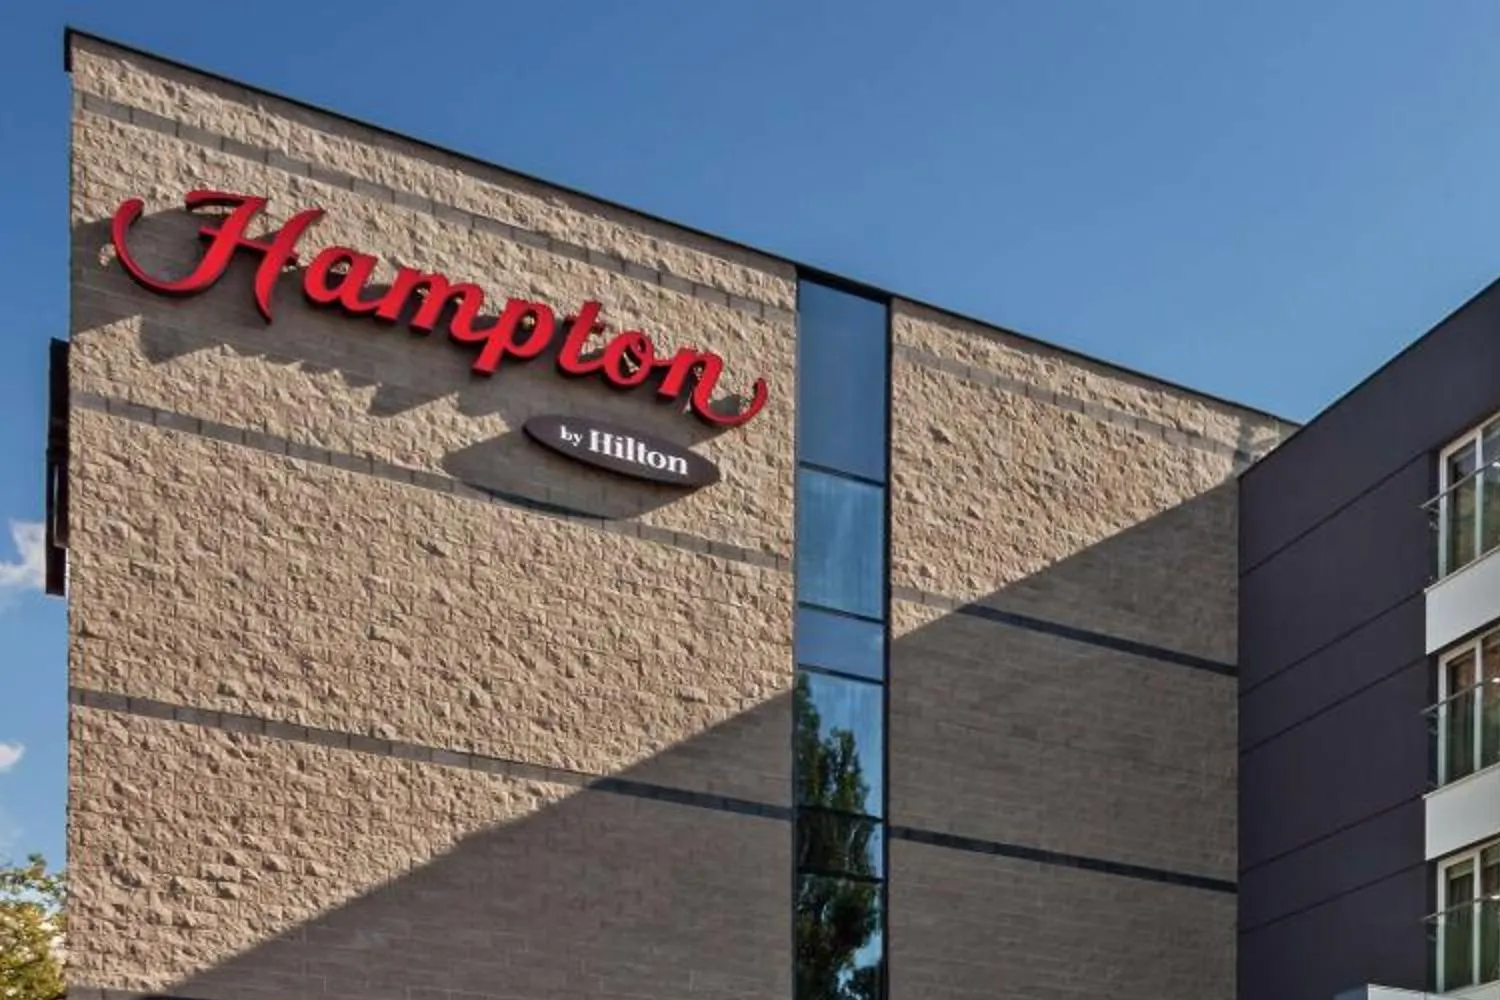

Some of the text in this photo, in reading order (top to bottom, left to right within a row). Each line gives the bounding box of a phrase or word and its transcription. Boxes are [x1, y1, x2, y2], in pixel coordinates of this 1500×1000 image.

[111, 189, 768, 426] Hampton
[560, 424, 689, 475] by Hilton
